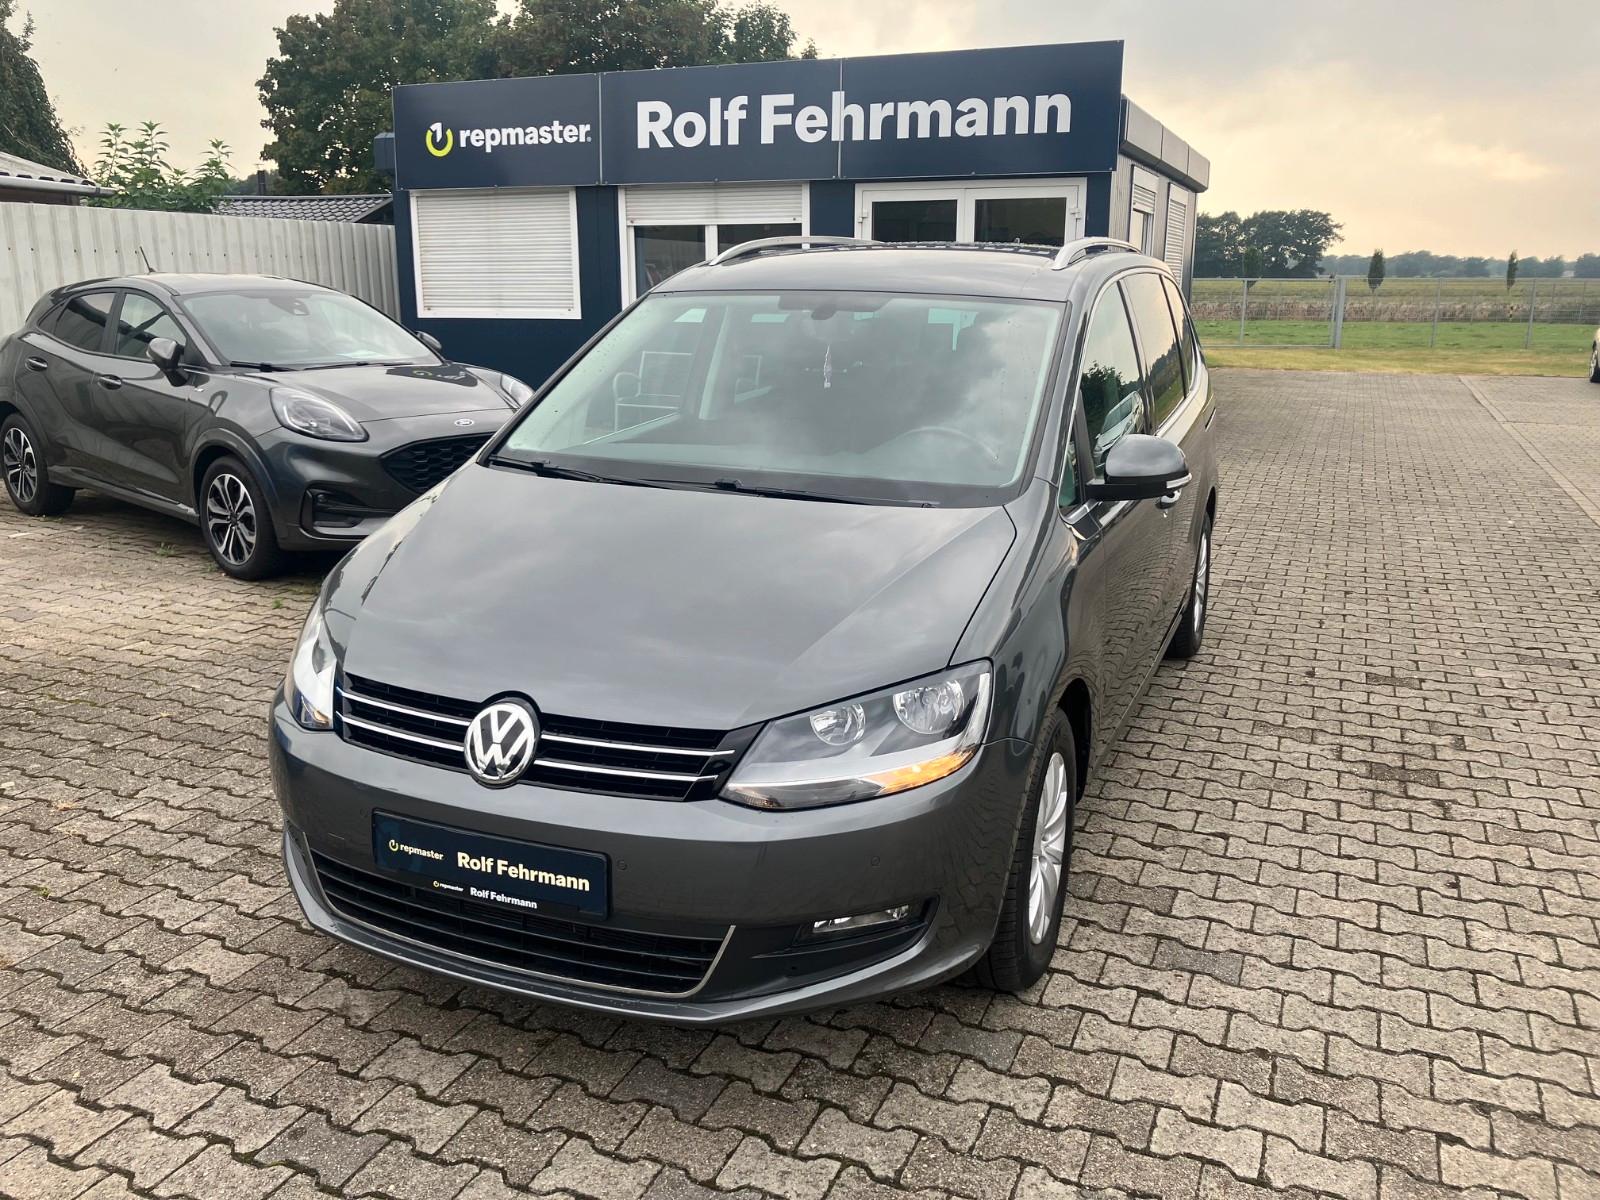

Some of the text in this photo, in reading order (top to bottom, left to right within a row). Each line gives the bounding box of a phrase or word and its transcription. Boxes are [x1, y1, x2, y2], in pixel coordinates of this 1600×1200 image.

[636, 90, 1072, 149] Rolf Fehrmann
[468, 705, 532, 778] VW
[400, 843, 445, 861] repmaster
[457, 851, 590, 892] Rolf Fehrmann
[470, 886, 490, 899] Rolf
[490, 891, 538, 910] Fehrmann
